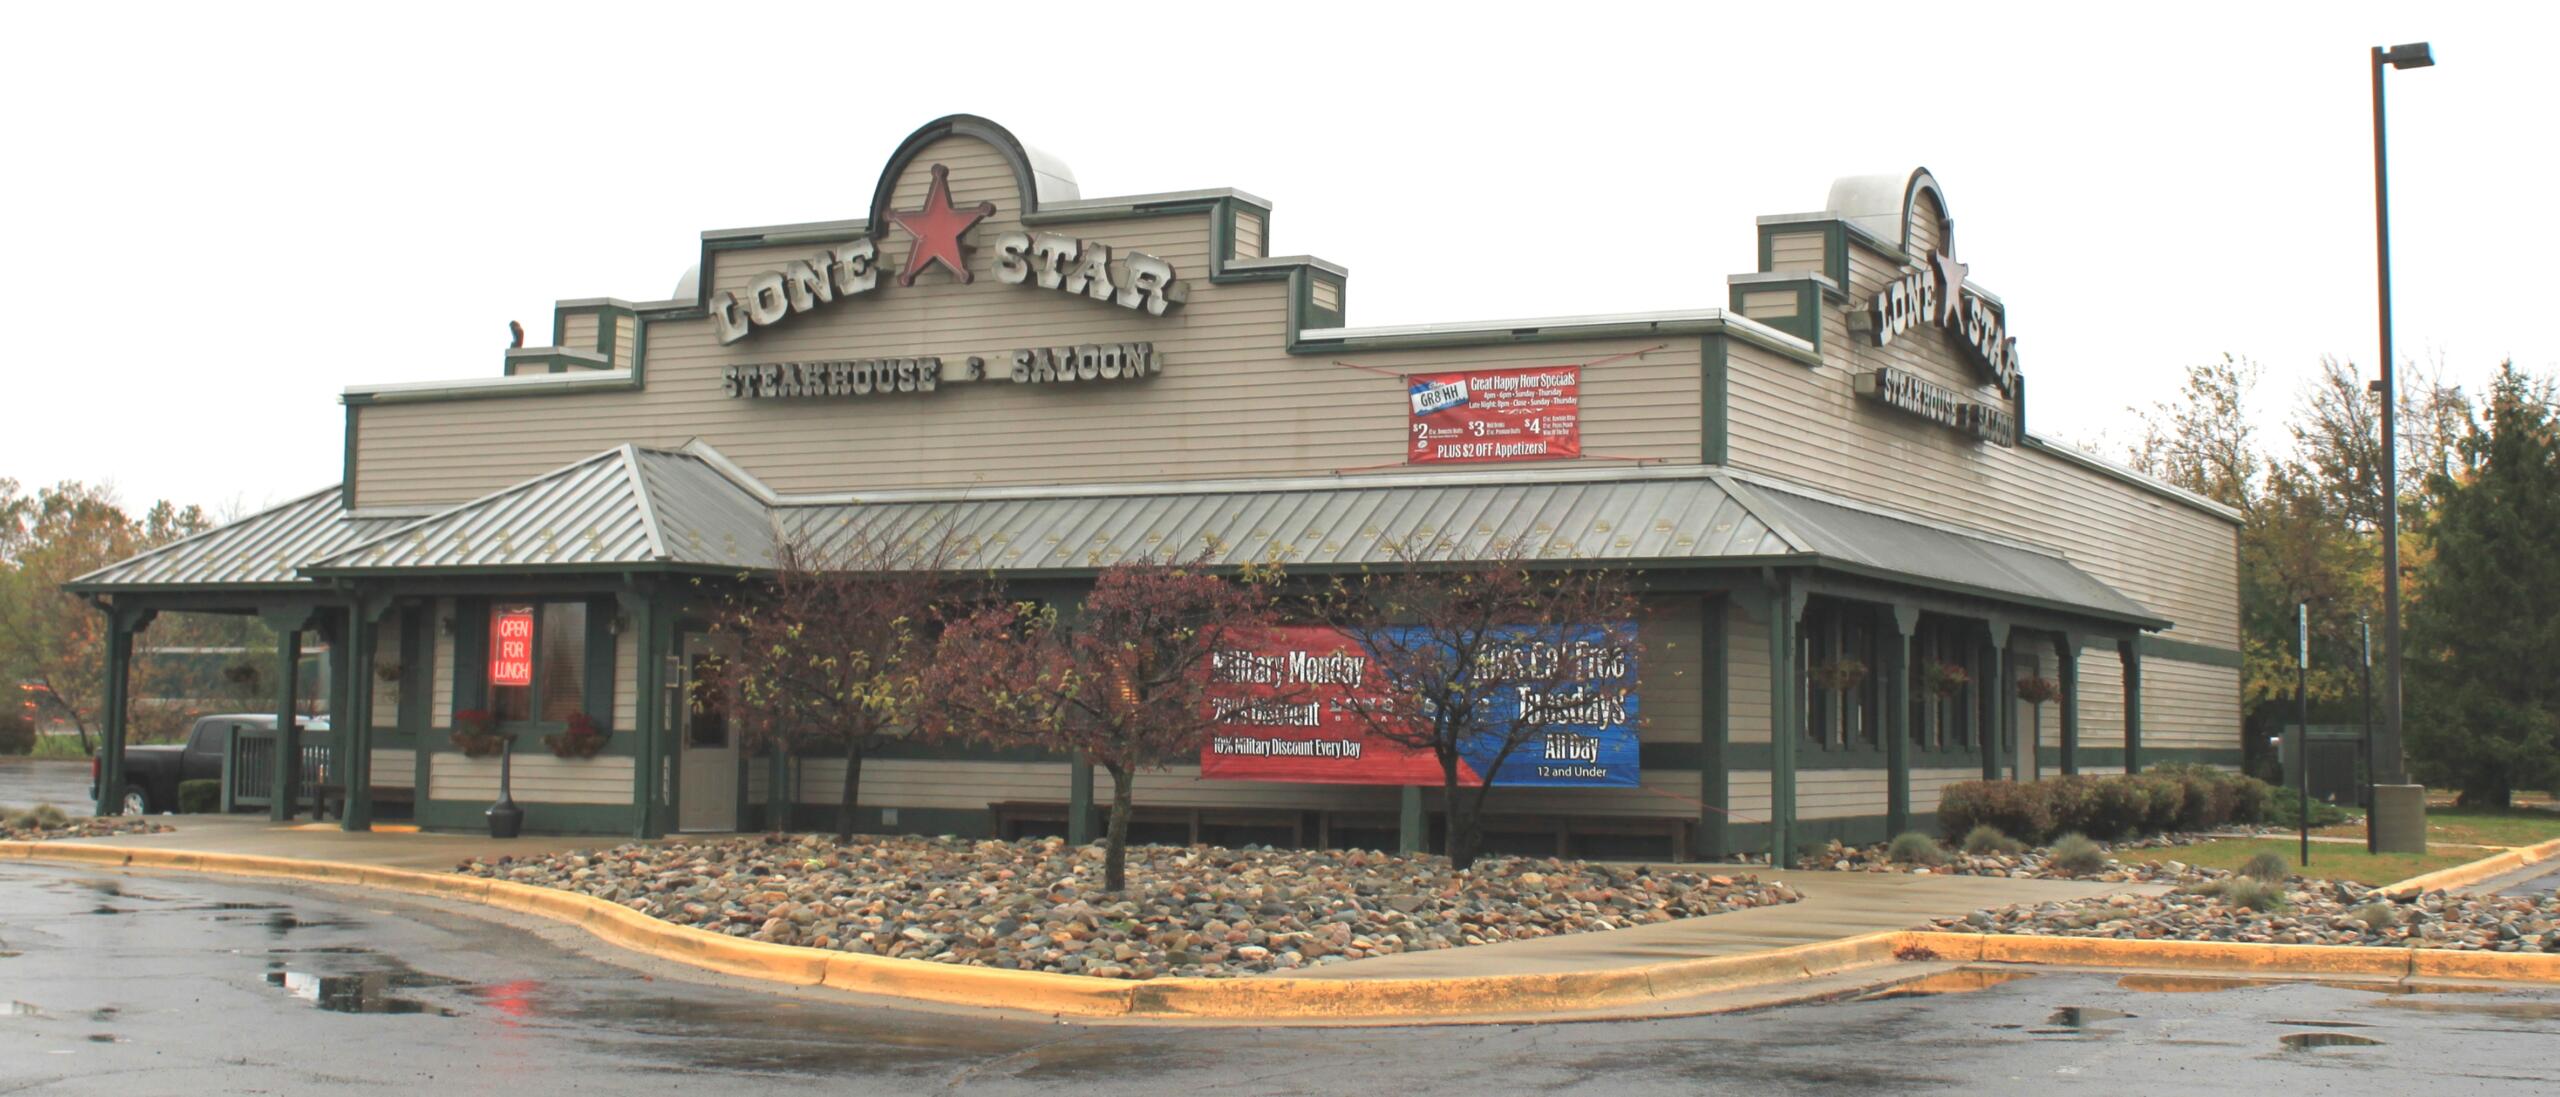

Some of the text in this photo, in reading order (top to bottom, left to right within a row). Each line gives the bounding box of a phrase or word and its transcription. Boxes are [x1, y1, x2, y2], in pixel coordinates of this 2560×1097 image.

[709, 230, 1176, 346] LONE STAR
[1876, 271, 2021, 398] LONE STAR
[722, 357, 942, 398] STEAKHOUSE
[1011, 342, 1154, 383] SALOON
[1471, 372, 1575, 391] Great Happy Hour Specials
[1420, 391, 1441, 407] GR8
[1442, 385, 1459, 401] HH
[1884, 367, 1957, 427] STEAKHOUSE
[1437, 441, 1547, 458] PLUS $2 OFF Appetizers!
[501, 620, 528, 637] OPEN
[503, 641, 524, 658] FOR
[495, 661, 528, 679] LUNCH
[1289, 651, 1365, 688] Monday
[1214, 737, 1360, 759] 10% Military Discount Every Day
[1545, 734, 1598, 763] All Day
[1538, 766, 1606, 777] 12 and Under
